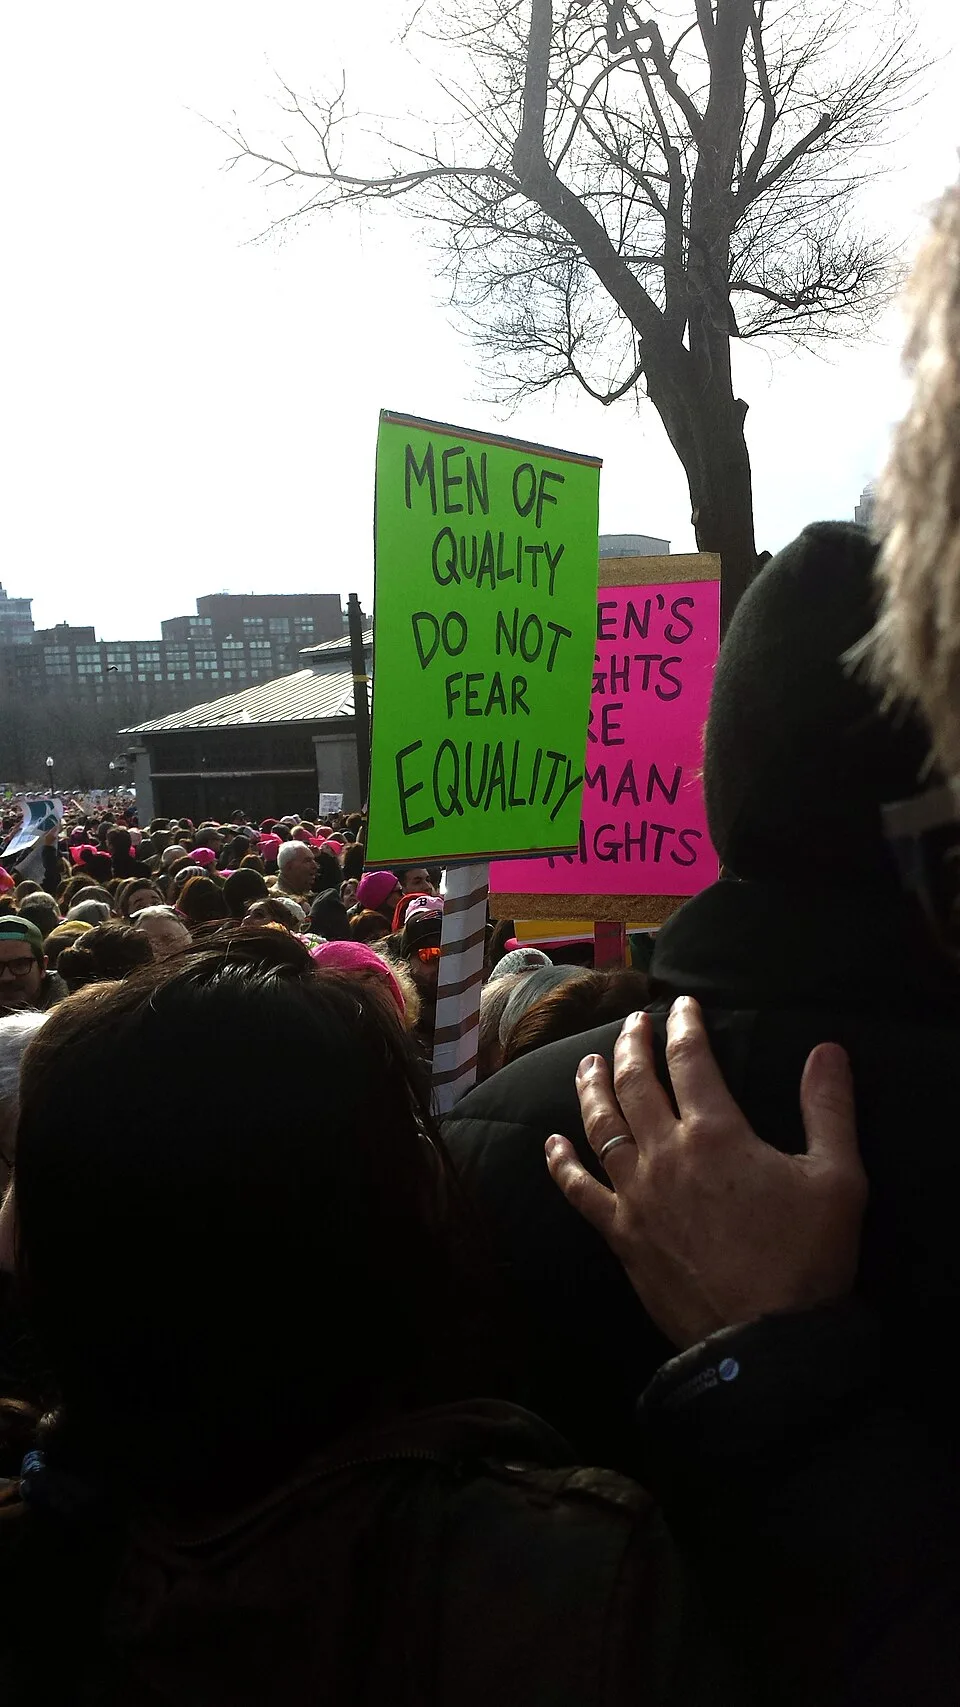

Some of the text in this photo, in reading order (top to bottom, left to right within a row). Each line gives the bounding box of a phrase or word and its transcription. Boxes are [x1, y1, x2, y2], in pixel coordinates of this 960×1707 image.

[404, 441, 566, 528] MEN OF
[432, 526, 565, 597] QUALITY
[412, 607, 572, 672] DO NOT
[445, 671, 531, 720] FEAR
[395, 738, 584, 836] EQUALITY
[547, 819, 703, 869] IGHTS
